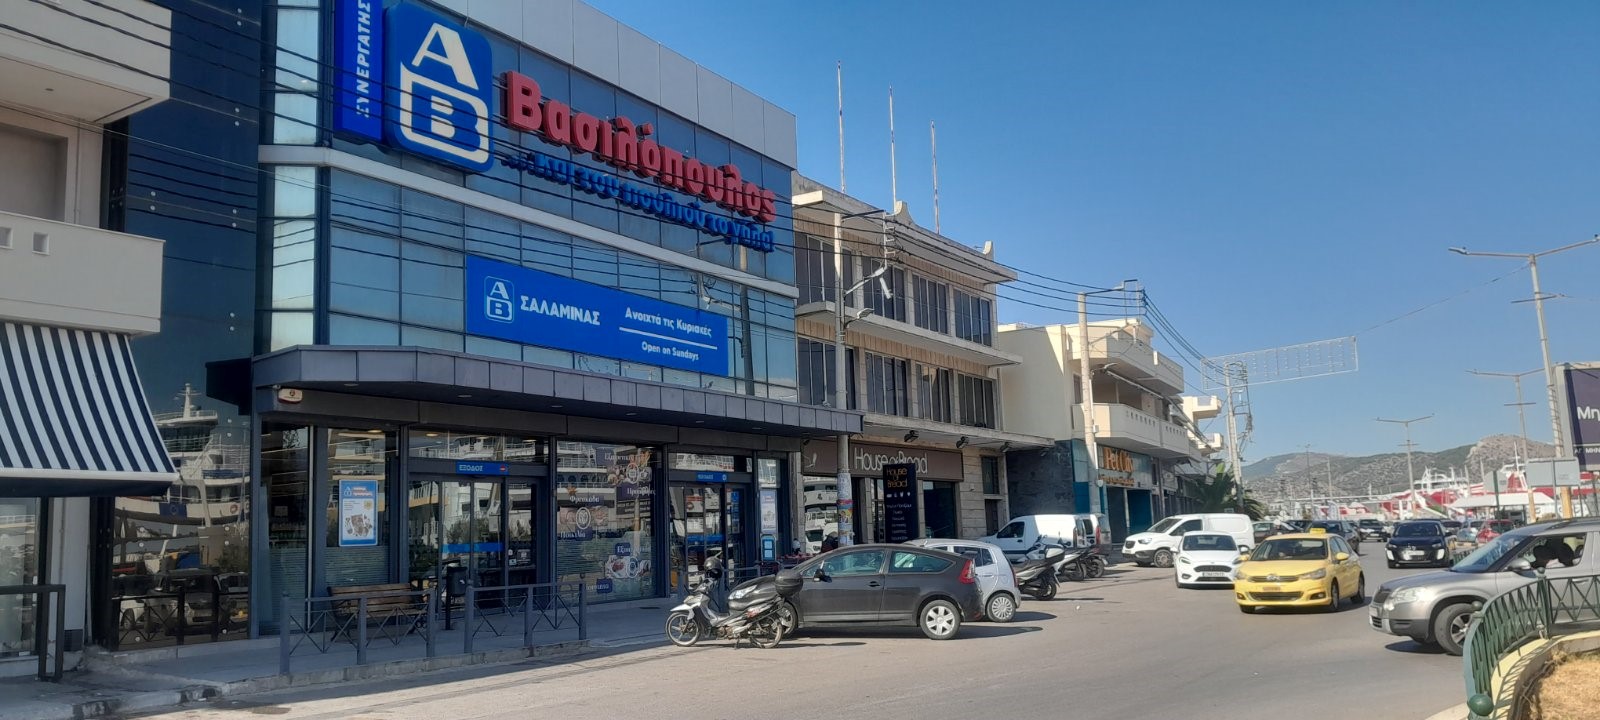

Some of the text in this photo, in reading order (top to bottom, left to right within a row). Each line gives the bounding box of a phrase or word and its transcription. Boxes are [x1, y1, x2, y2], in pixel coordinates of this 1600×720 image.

[355, 0, 371, 119] ΣΥΝΕΡΓΑΤΗΣ
[505, 69, 778, 223] Βασιλόπουλος
[520, 295, 601, 325] ΣΑΛΑΜΙΝΑΣ
[625, 306, 712, 338] Ανοιχτά τις Κυριακές
[641, 341, 699, 362] Open on Sundays
[854, 447, 889, 472] House
